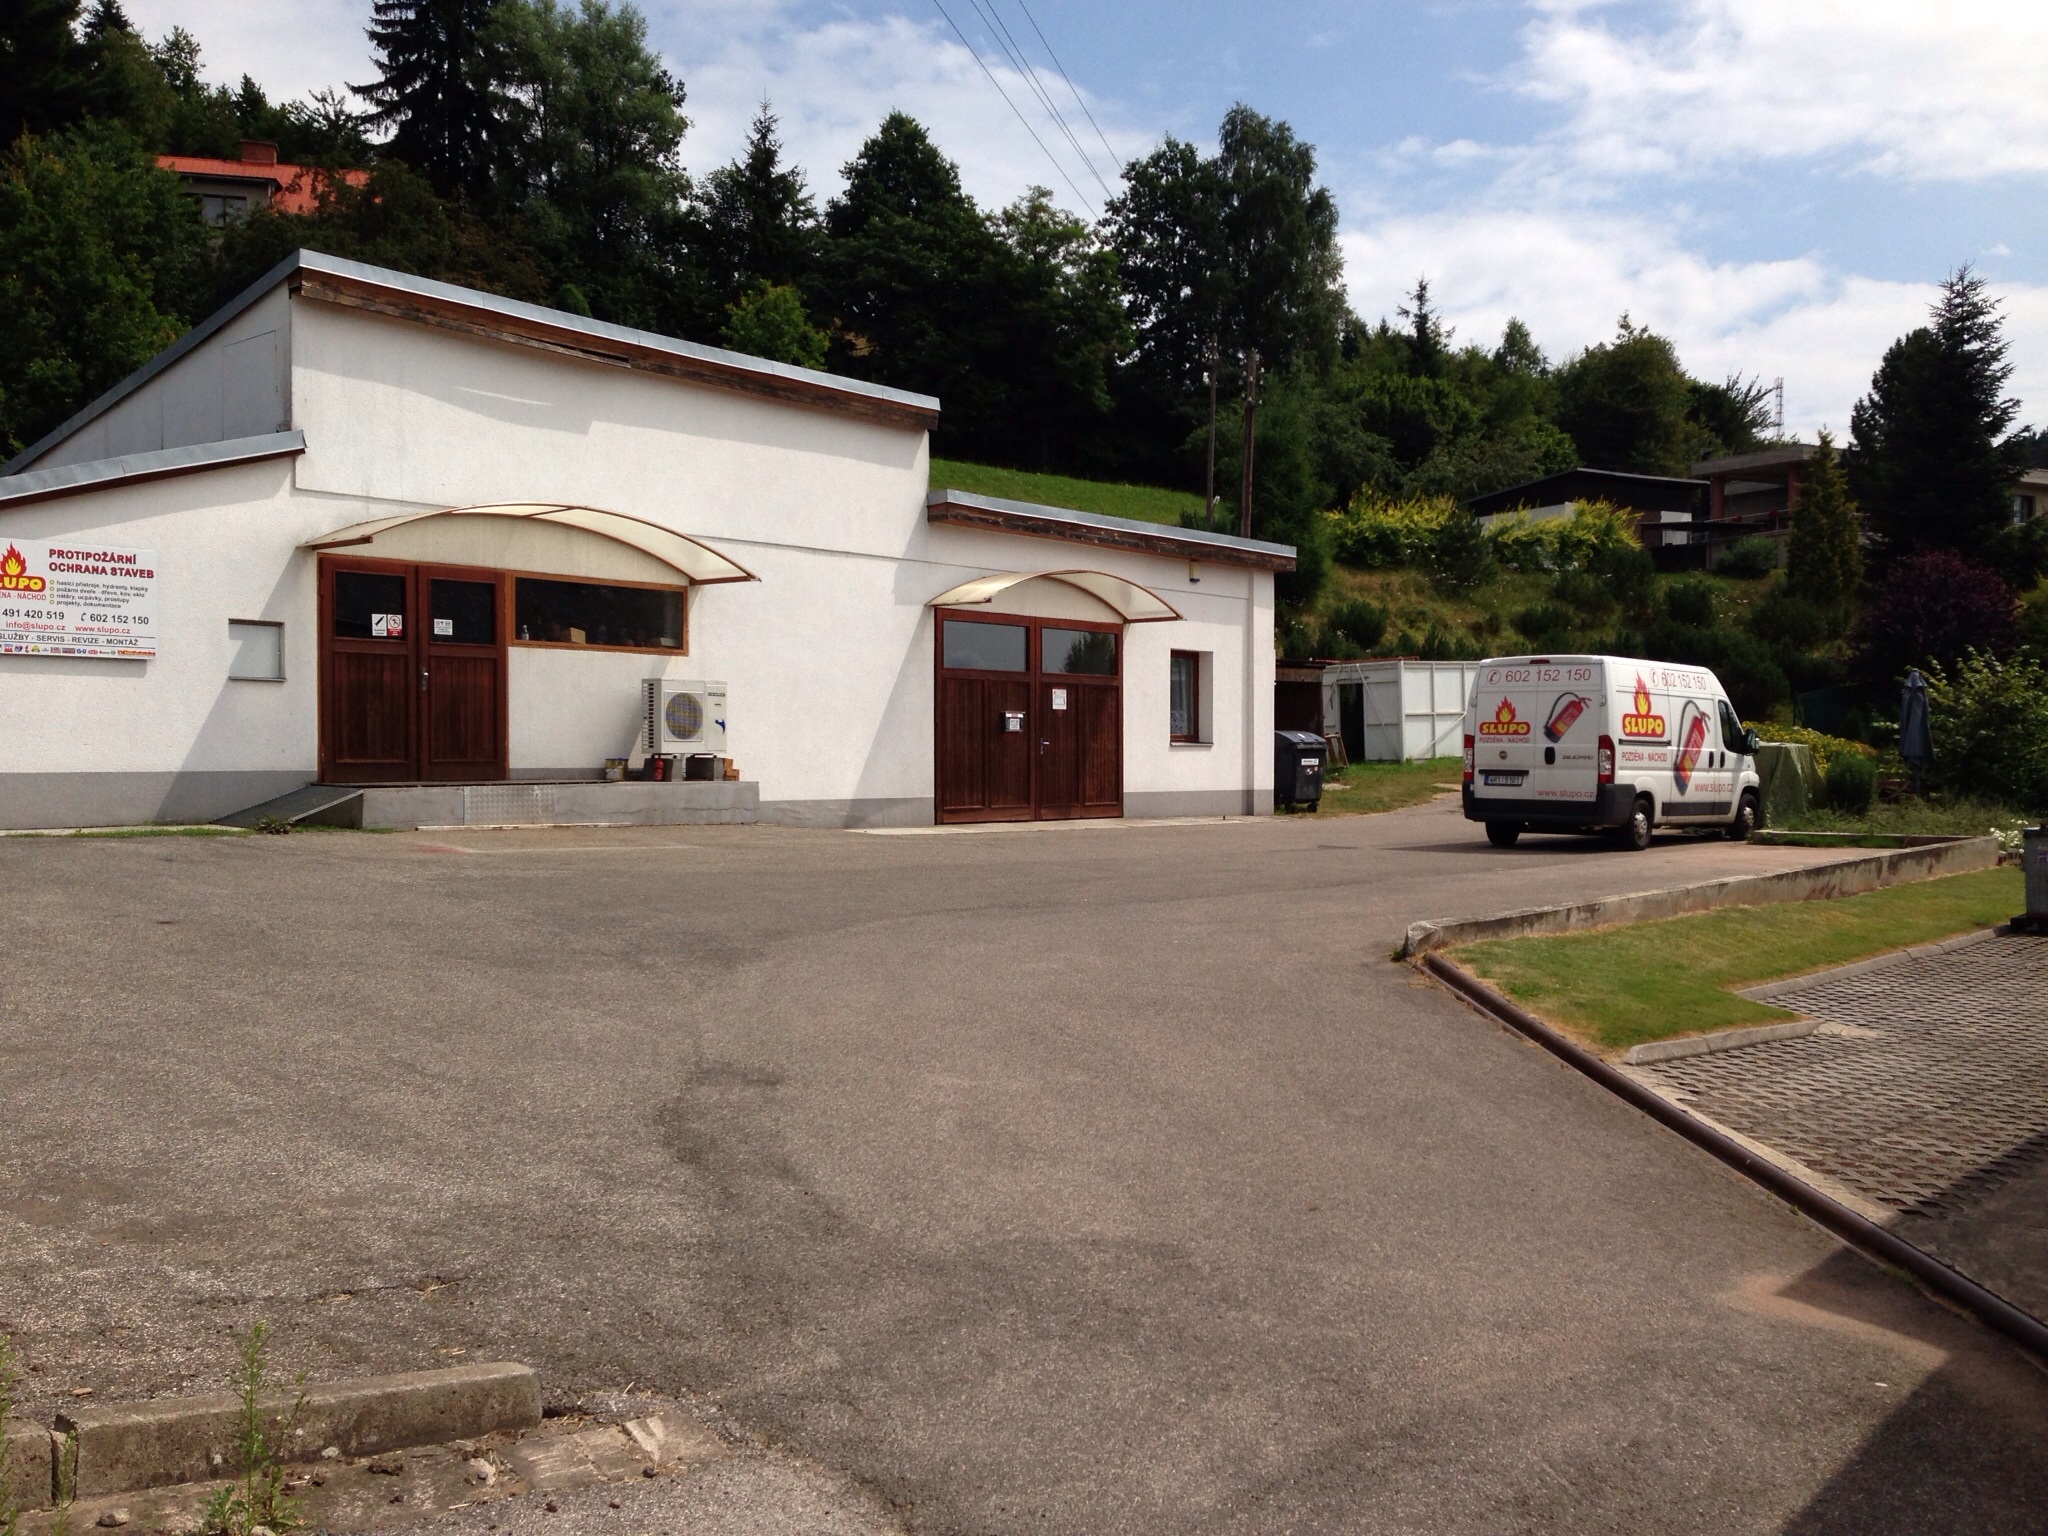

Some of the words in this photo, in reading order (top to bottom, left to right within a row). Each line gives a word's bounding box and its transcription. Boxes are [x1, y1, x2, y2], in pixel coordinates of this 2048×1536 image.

[49, 548, 136, 564] PROTIPOŽÁRNÍ
[49, 562, 108, 576] OCHRANA
[110, 568, 154, 578] STAVEB
[17, 592, 46, 600] NÁCHOD
[2, 608, 20, 618] 491
[24, 609, 43, 619] 420
[46, 611, 64, 620] 519
[90, 613, 108, 623] 602
[112, 615, 128, 624] 152
[132, 616, 149, 625] 150
[6, 620, 66, 631] info@slupo.cz
[75, 626, 131, 634] www.slupo.cz
[1506, 670, 1530, 682] 602
[1536, 670, 1560, 681] 152
[1567, 668, 1591, 680] 150
[1662, 673, 1676, 687] 602
[1678, 675, 1690, 688] 152
[1693, 676, 1706, 690] 150
[1482, 723, 1528, 734] SLUPO
[1624, 717, 1663, 734] SLUPO
[1622, 750, 1644, 760] POZDĚNA
[1648, 750, 1667, 762] NÁCHOD
[1694, 783, 1733, 792] www.slupo.cz
[1537, 790, 1594, 798] www.slupo.cz
